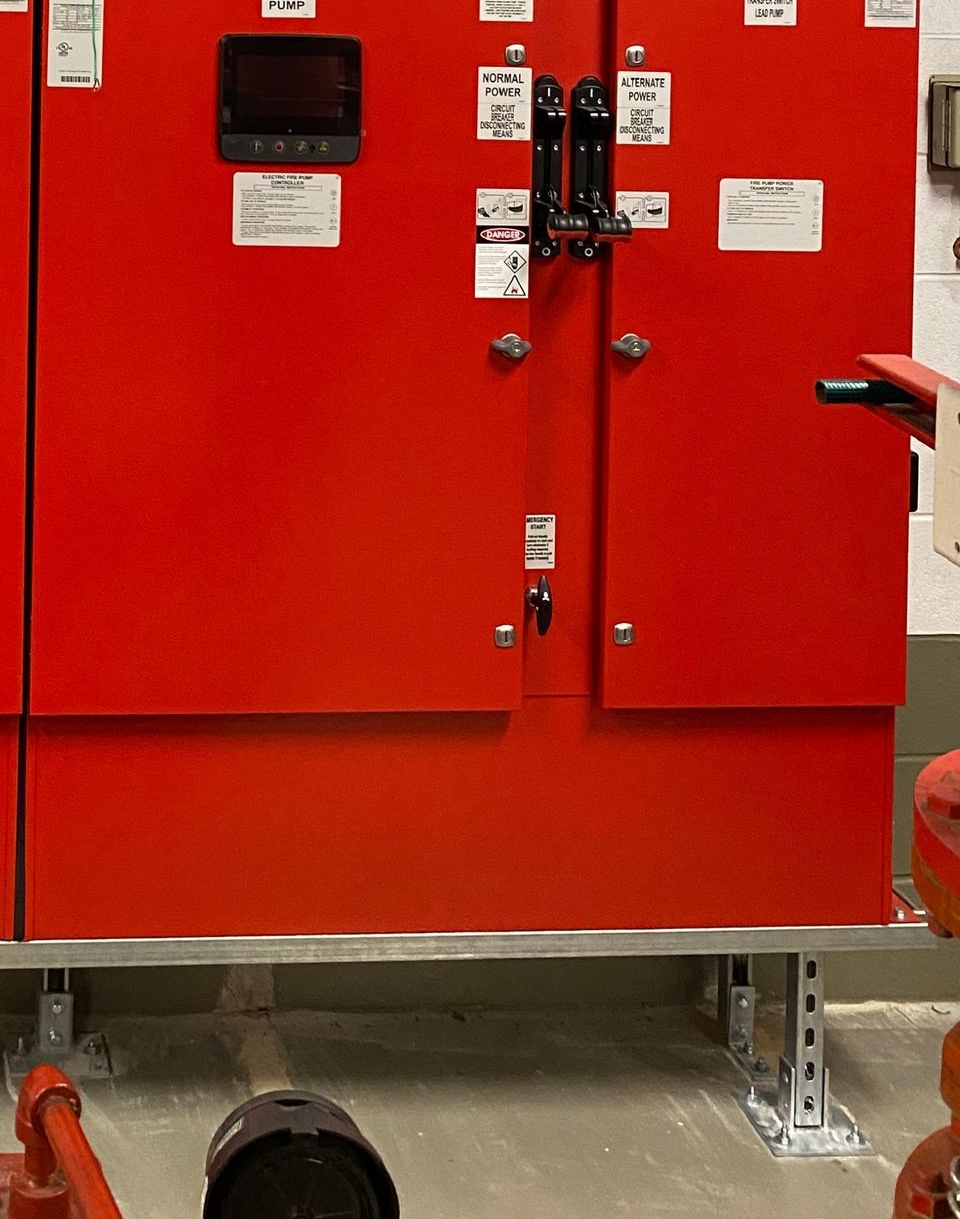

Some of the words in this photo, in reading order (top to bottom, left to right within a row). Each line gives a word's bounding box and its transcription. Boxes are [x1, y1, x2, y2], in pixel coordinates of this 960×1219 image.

[269, 0, 305, 10] PUMP
[755, 9, 768, 17] LEAD
[769, 9, 784, 17] PUMP
[483, 73, 524, 83] NORMAL
[621, 78, 665, 88] ALTERNATE
[485, 87, 521, 97] POWER
[628, 92, 656, 101] POWER
[491, 113, 514, 121] BREAKER
[630, 109, 654, 117] CIRCUIT
[480, 121, 525, 130] DISCONNECTING
[630, 117, 653, 126] BREAKER
[492, 130, 513, 138] MEANS
[620, 126, 664, 134] DISCONNECTING
[632, 134, 652, 142] MEANS
[486, 231, 520, 239] DANGER
